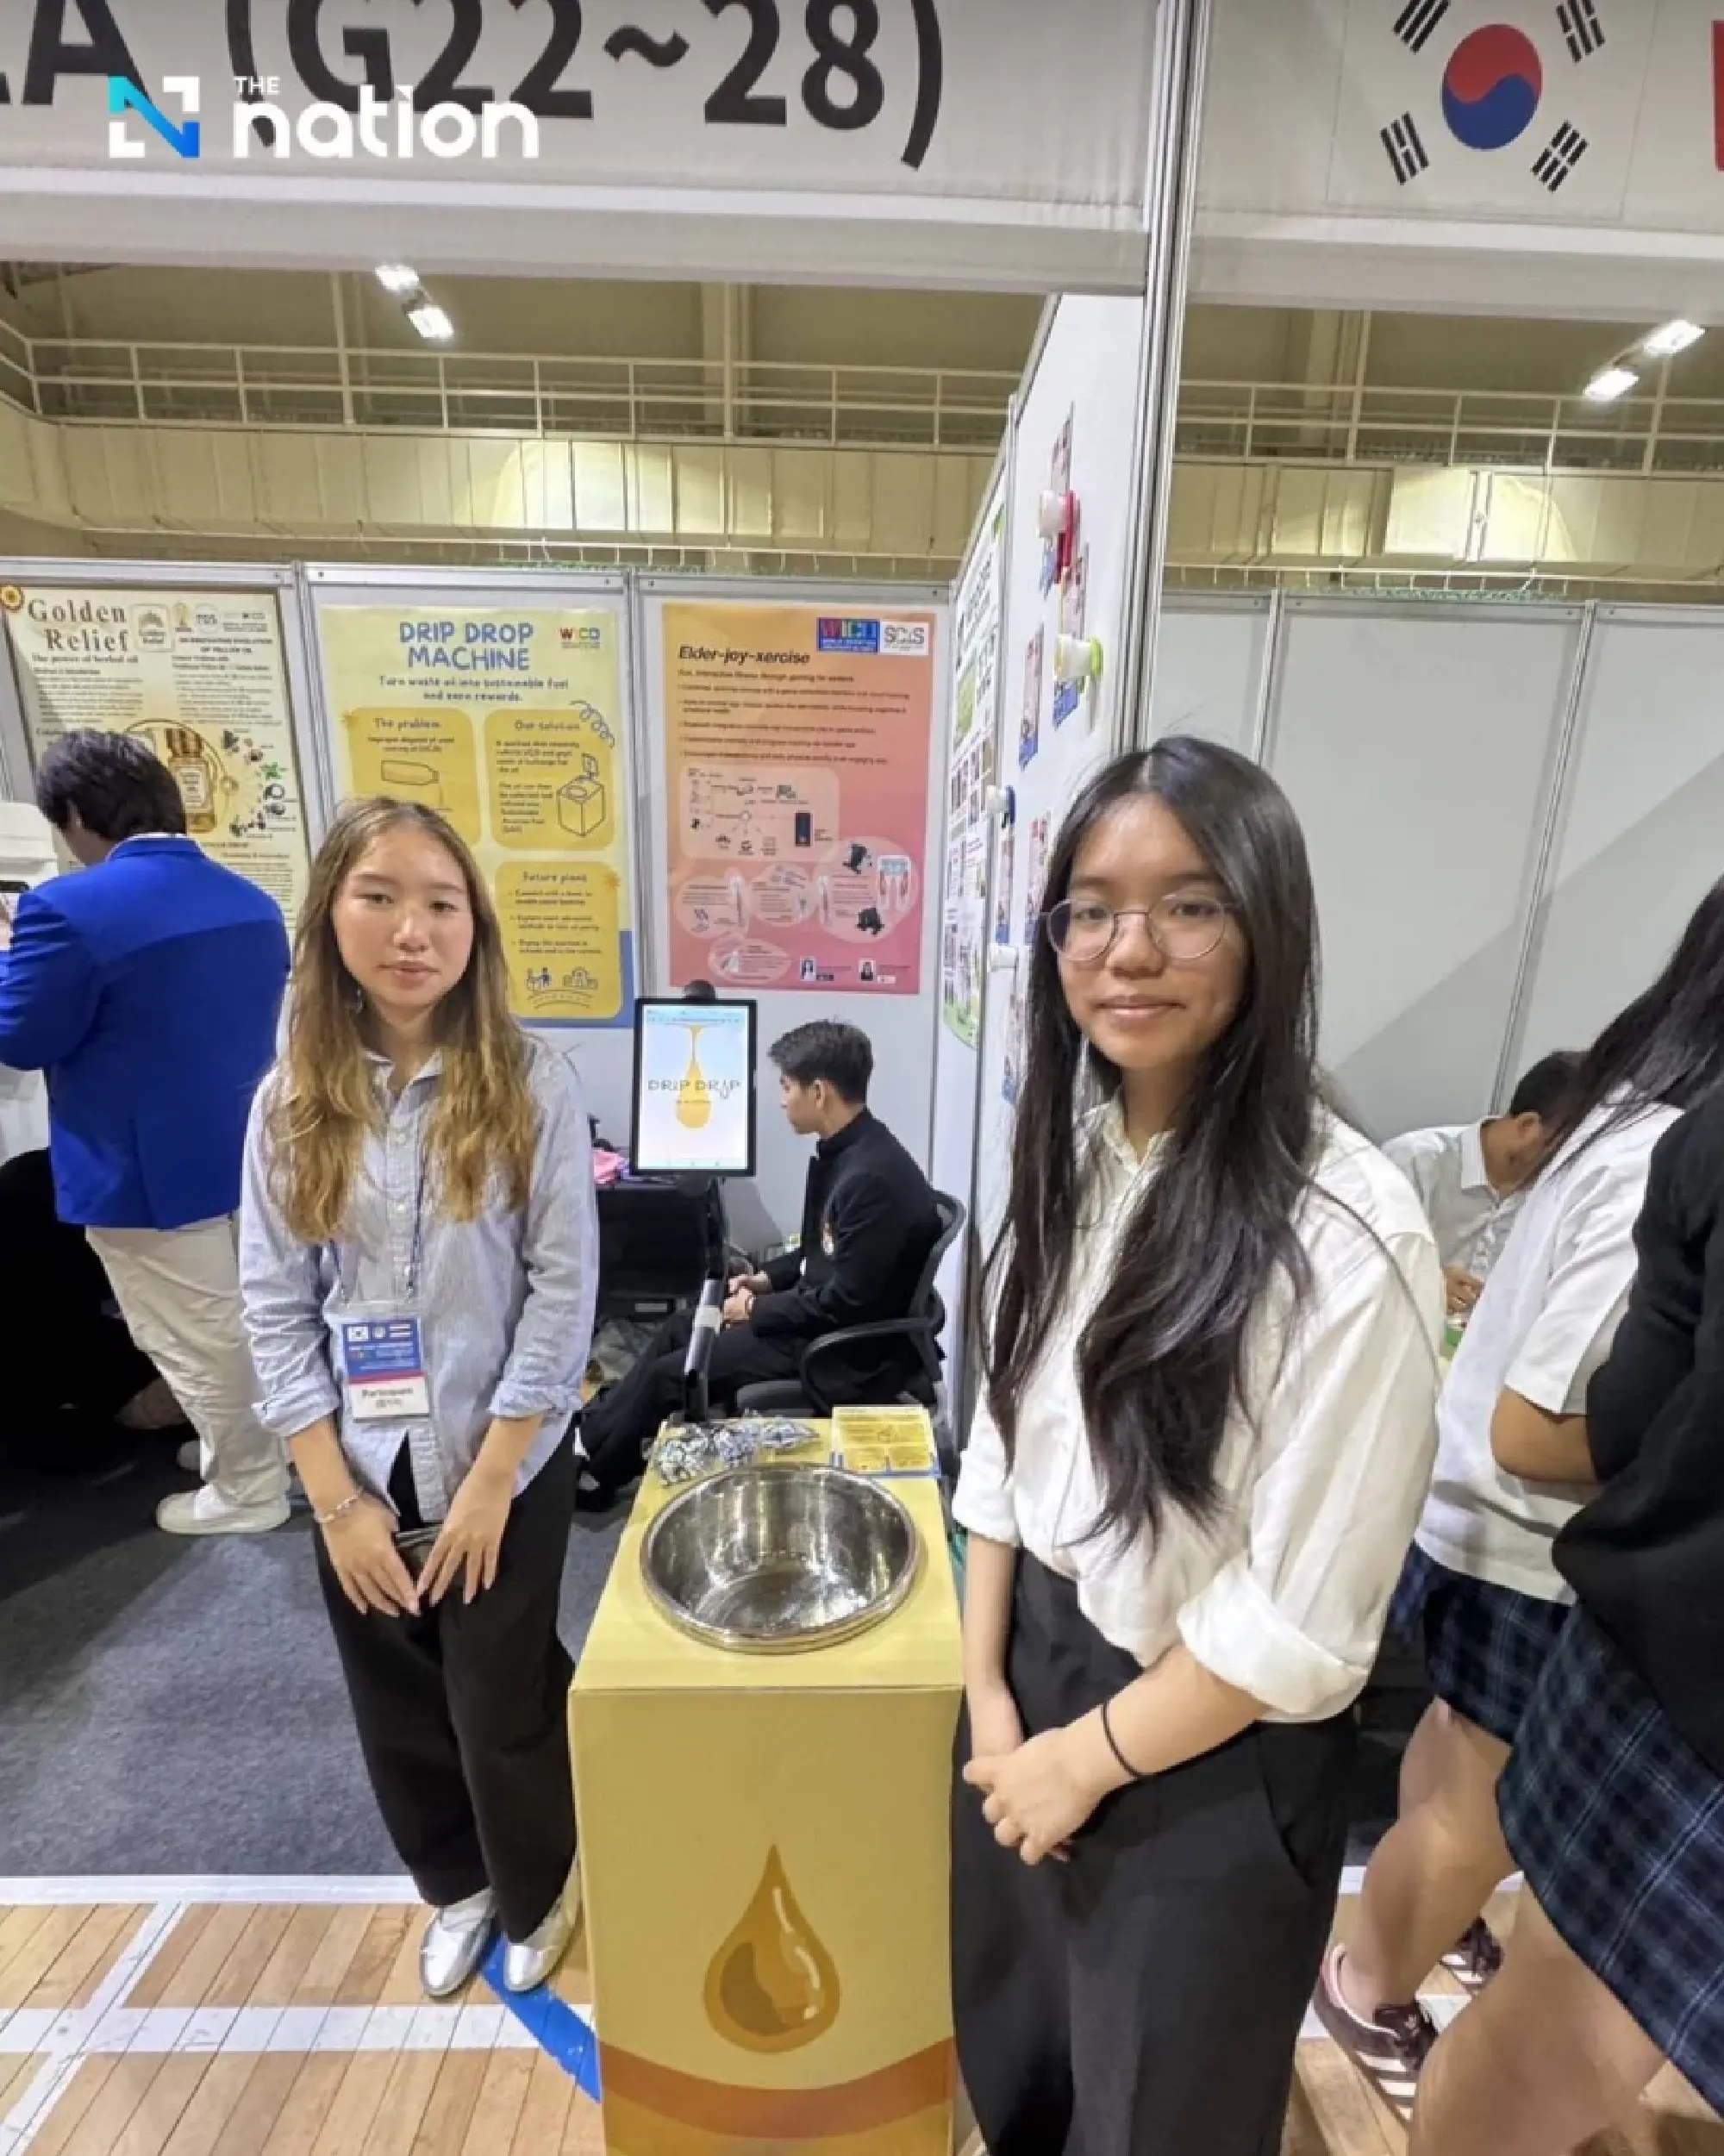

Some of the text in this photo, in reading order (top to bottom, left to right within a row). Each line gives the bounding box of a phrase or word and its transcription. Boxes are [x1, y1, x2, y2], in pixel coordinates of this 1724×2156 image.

[0, 0, 152, 106] A
[28, 598, 128, 622] Golden
[46, 628, 128, 652] Relief
[399, 622, 534, 644] DRIP DROP
[408, 646, 531, 671] MACHINE
[380, 675, 569, 689] Turn waste oil into sustainable fuel
[423, 690, 443, 700] and
[373, 718, 394, 728] The
[515, 719, 533, 731] Our
[522, 871, 556, 883] Future
